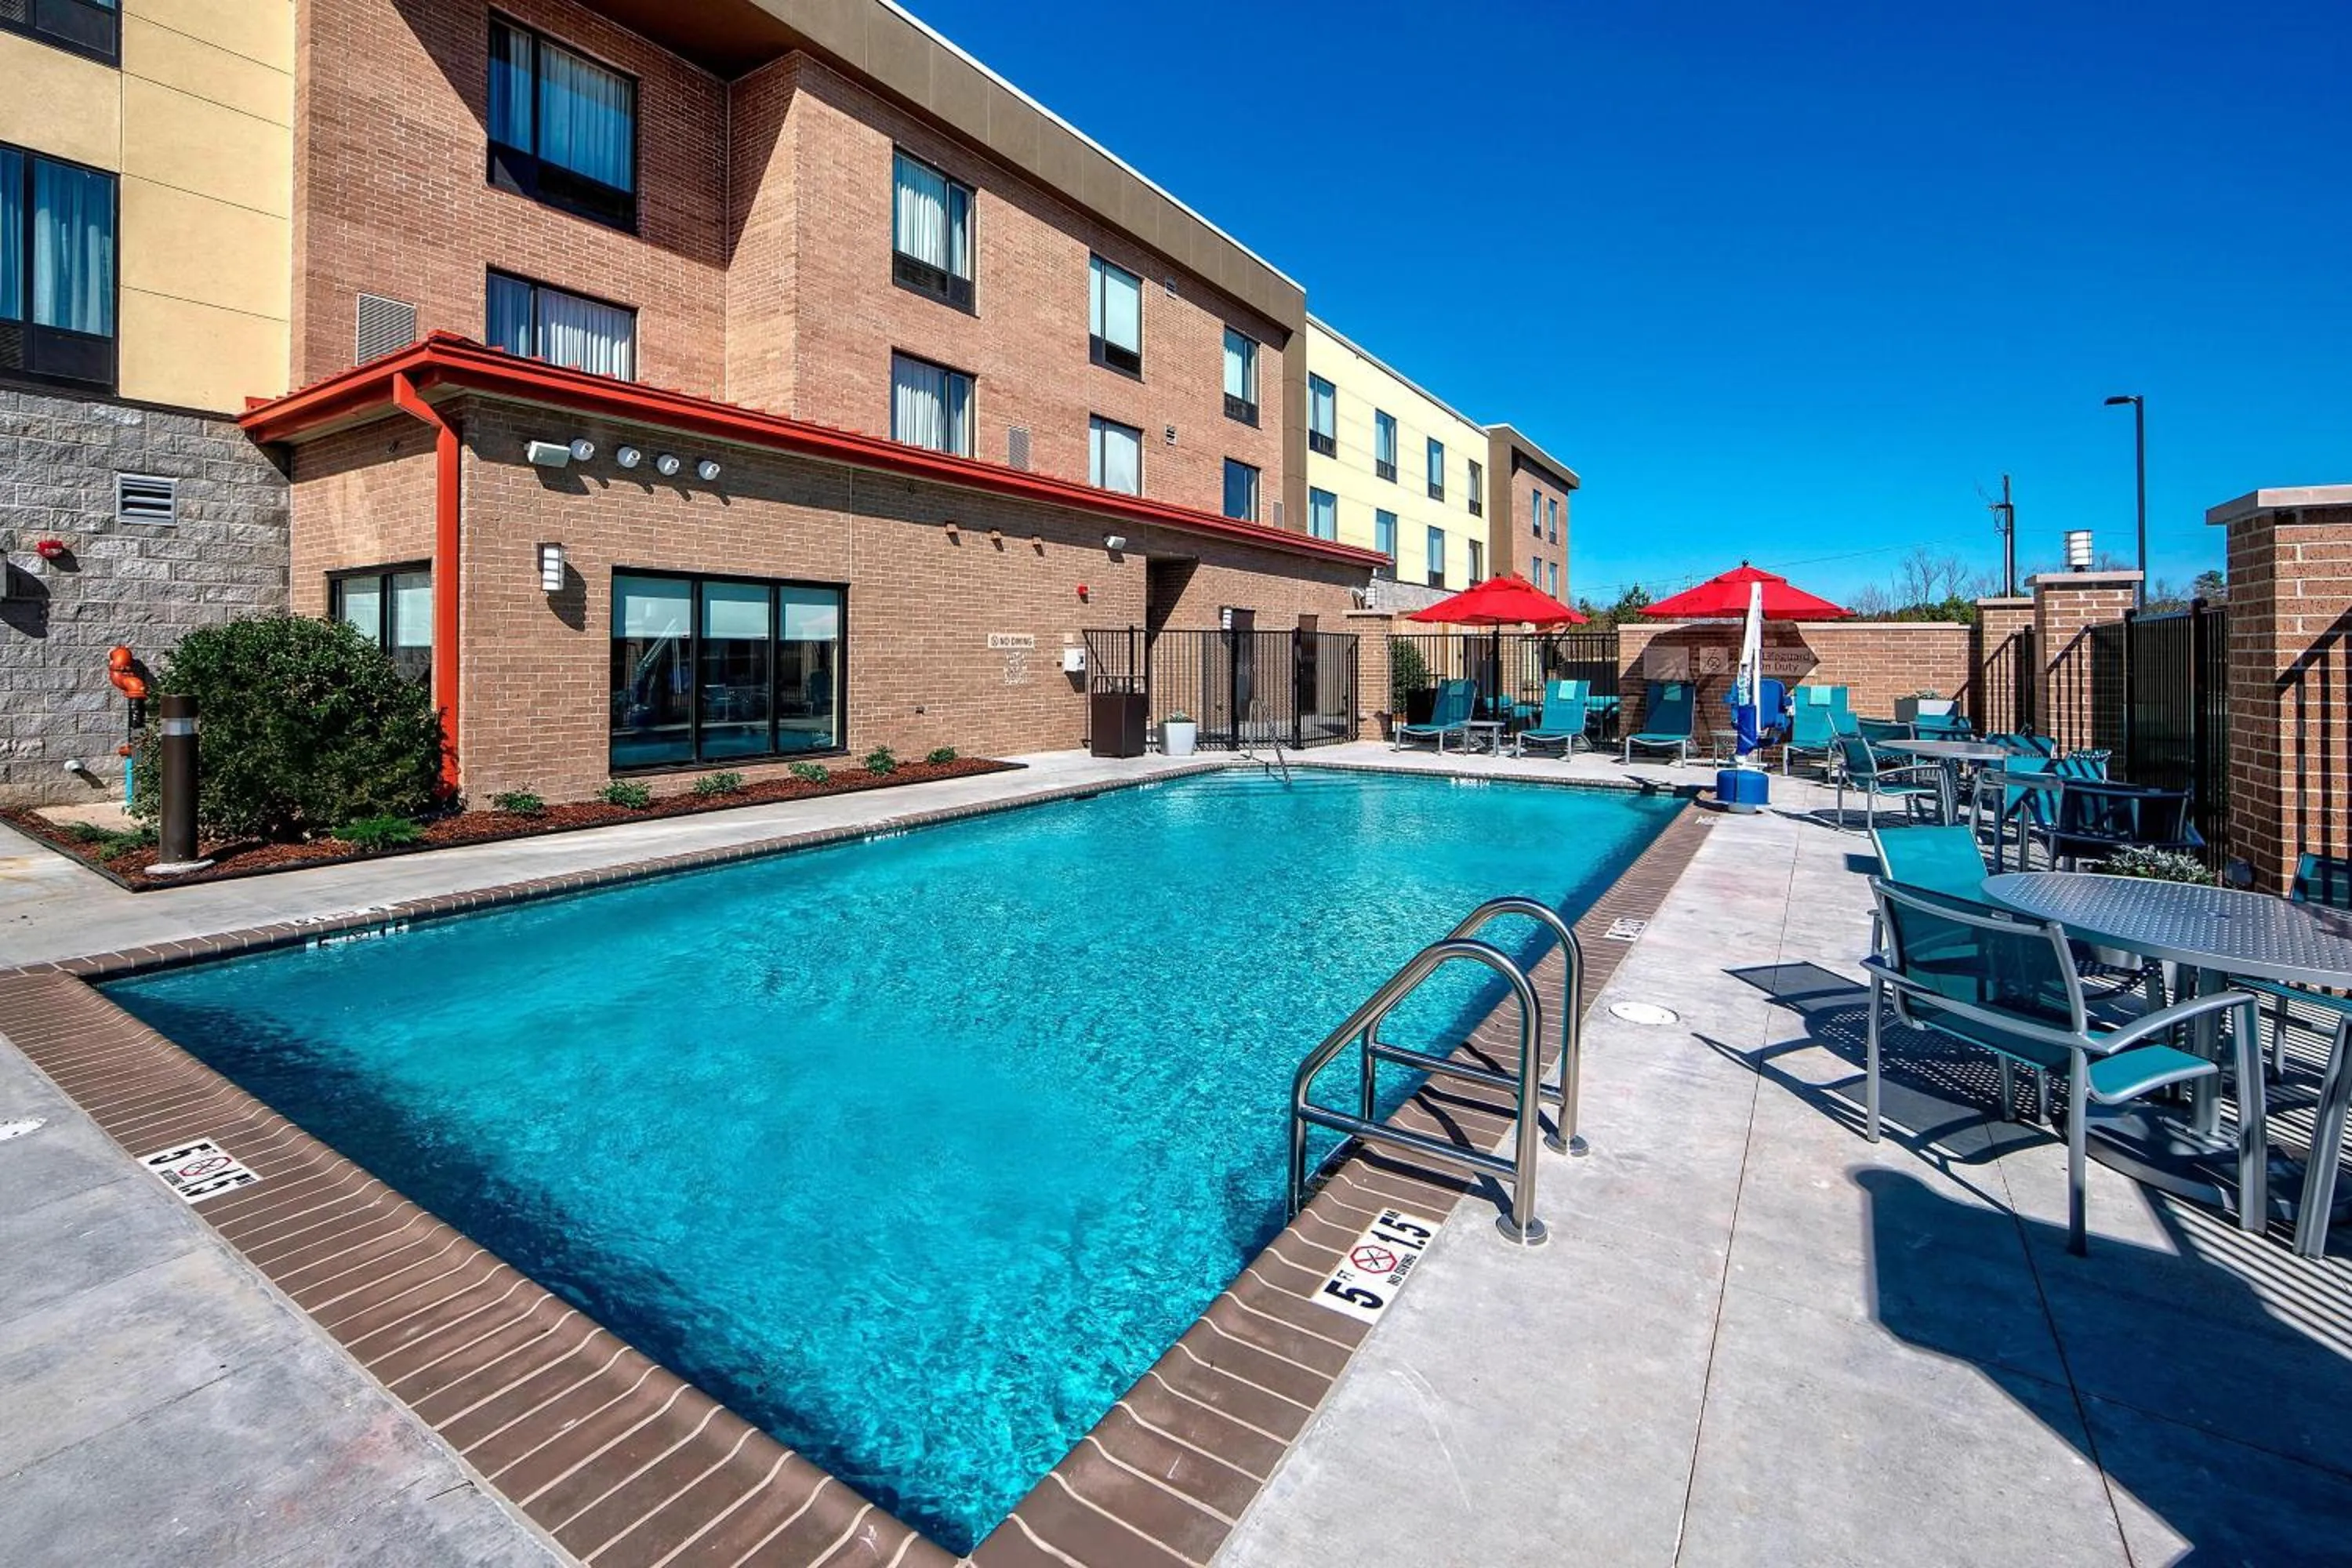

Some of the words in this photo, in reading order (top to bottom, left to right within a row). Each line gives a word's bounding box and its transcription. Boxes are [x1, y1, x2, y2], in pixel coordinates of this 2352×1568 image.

[1000, 637, 1011, 646] NO
[1011, 637, 1033, 647] DIVING
[1761, 652, 1810, 662] Lifeguard
[1774, 662, 1799, 673] Duty
[1370, 1216, 1432, 1250] 1.5
[1323, 1279, 1384, 1309] 5
